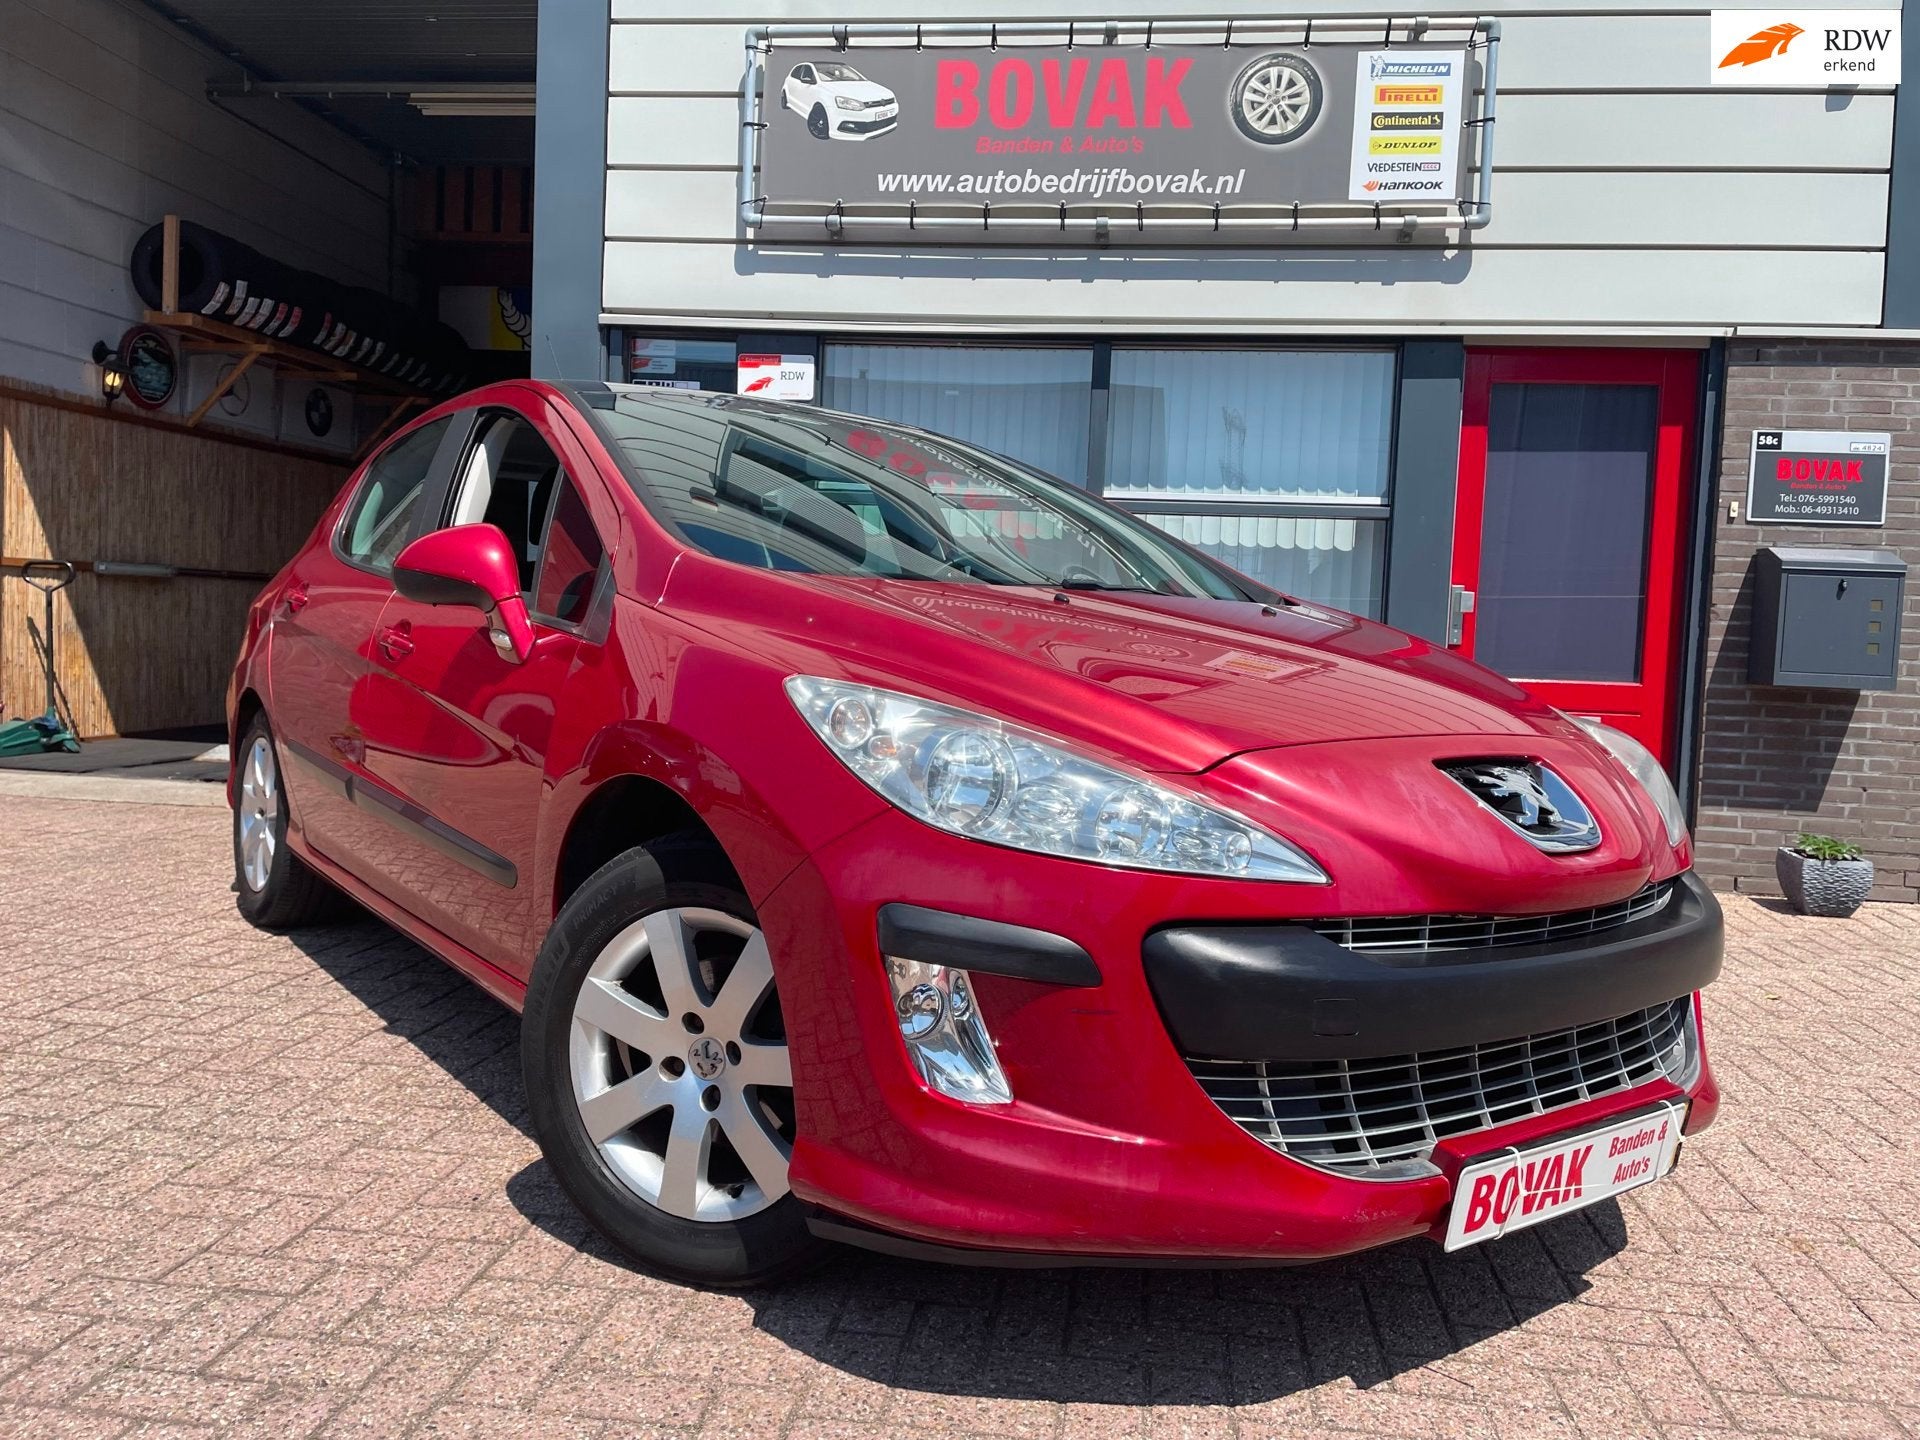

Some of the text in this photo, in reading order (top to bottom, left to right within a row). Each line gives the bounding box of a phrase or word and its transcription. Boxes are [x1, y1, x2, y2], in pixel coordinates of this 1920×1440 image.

[1386, 65, 1449, 73] MICHELIN
[934, 57, 1195, 130] BOVAK
[1379, 87, 1438, 102] PIRELLI
[1373, 115, 1431, 128] Continental
[976, 136, 1144, 154] Banden & Auto's
[1383, 141, 1437, 149] DUNLOP
[1367, 162, 1423, 173] VREDESTEIN
[877, 168, 1246, 199] www.autobedrijfbovak.nl
[780, 370, 806, 381] RDW
[1758, 435, 1778, 445] 58c
[1776, 457, 1863, 482] BOVAK
[1780, 494, 1857, 504] Tel.: 076-5991540
[1775, 504, 1860, 515] Mob.: 06-49313410
[1612, 1156, 1651, 1185] Auto's
[1463, 1120, 1669, 1235] BOVAK Banden &
